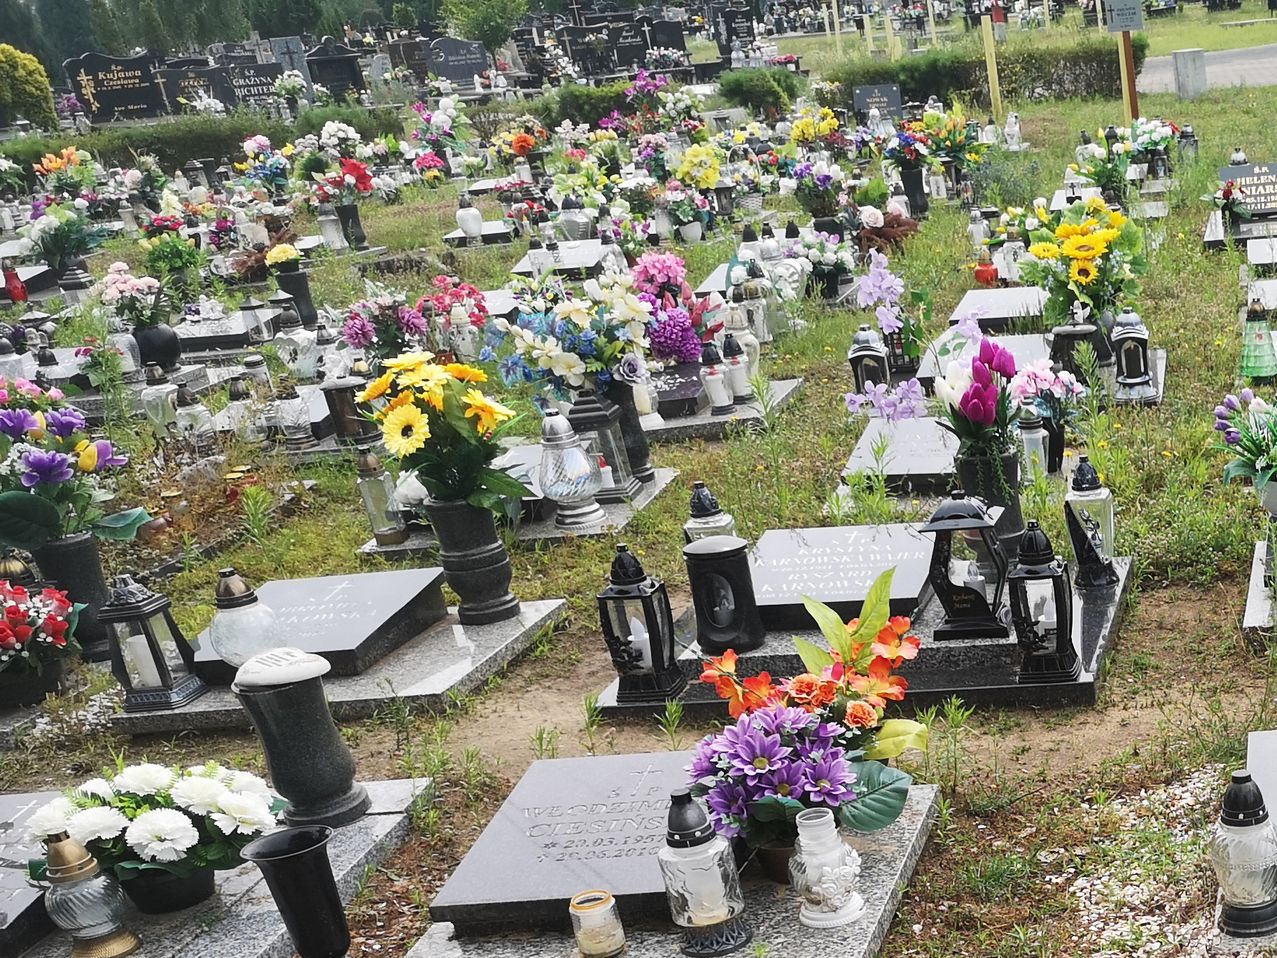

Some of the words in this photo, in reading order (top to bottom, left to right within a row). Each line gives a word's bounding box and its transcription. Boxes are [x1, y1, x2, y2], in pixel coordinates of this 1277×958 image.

[98, 70, 142, 80] Kujawa
[232, 76, 273, 86] GRAŻYNA
[234, 85, 276, 97] RICHTER
[788, 570, 873, 581] RYSZARD
[761, 580, 876, 592] KARNOWSK
